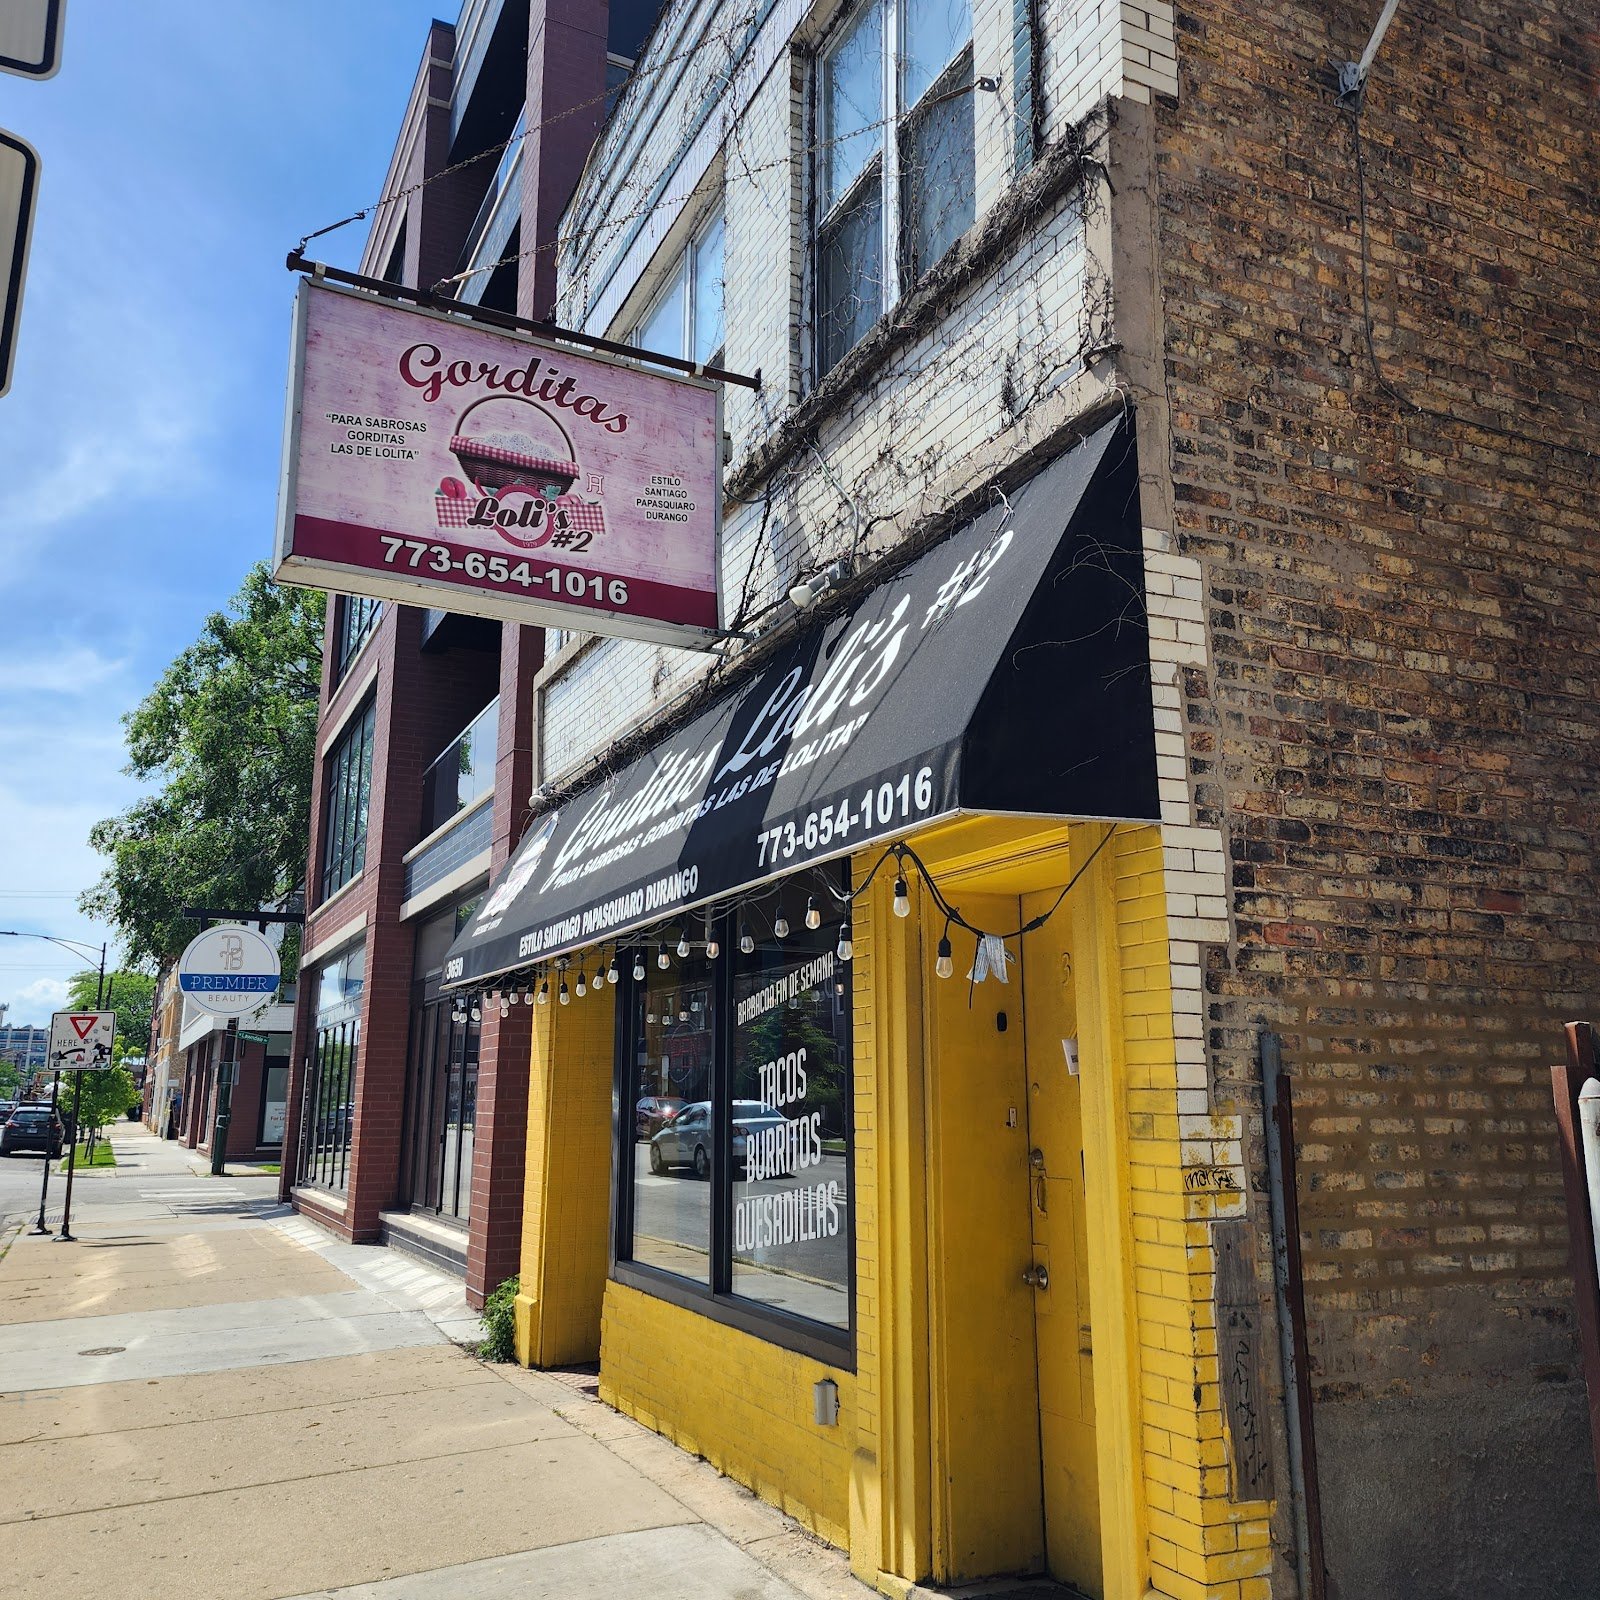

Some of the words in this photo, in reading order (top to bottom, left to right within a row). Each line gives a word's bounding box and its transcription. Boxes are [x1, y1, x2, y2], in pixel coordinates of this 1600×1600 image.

[399, 343, 629, 434] Gorditas
[365, 417, 427, 432] SABROSAS
[347, 430, 405, 445] GORDITAS
[331, 443, 353, 455] LAS
[356, 445, 372, 456] DE
[644, 487, 687, 498] SANTIAGO
[651, 476, 681, 486] ESTILO
[636, 498, 695, 511] PAPASQUIARO
[646, 511, 688, 522] DURANGO
[550, 529, 593, 553] #2
[379, 535, 629, 606] 773-654-1016
[920, 530, 1014, 630] #2
[641, 793, 717, 848] GORDITAS
[713, 774, 753, 811] LAS
[748, 758, 782, 793] DE
[757, 766, 934, 868] 773-654-1016
[519, 929, 544, 958] ESTILO
[543, 914, 581, 948] SANTIAGO
[581, 888, 643, 936] PAPASQUIARO
[645, 864, 699, 912] DURANGO
[446, 957, 464, 980] 3650
[789, 969, 800, 998] DE
[800, 950, 834, 992] SEMANA
[190, 976, 268, 990] PREMIER
[208, 994, 250, 1002] BEAUTY
[57, 1039, 78, 1047] HERE
[758, 1047, 808, 1114] TACOS
[746, 1111, 822, 1184] BURRITOS
[735, 1180, 839, 1253] QUESADILLAS
